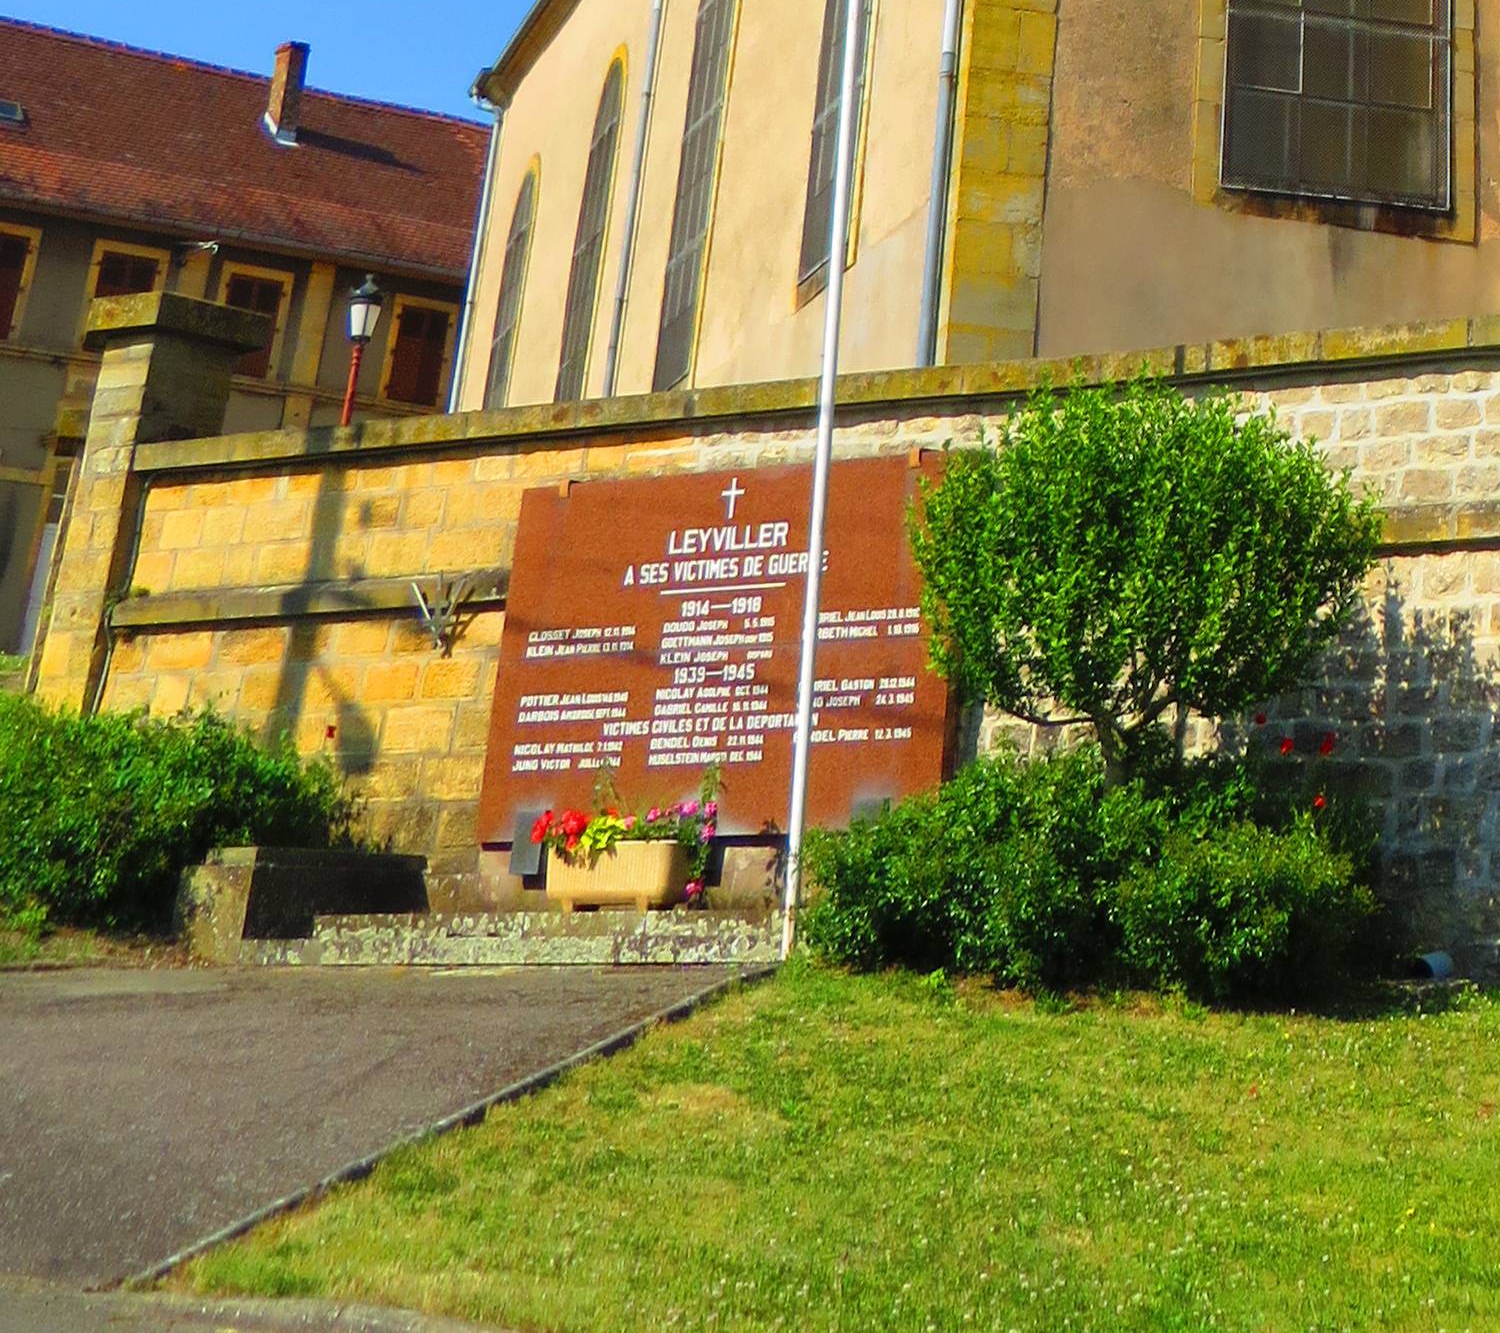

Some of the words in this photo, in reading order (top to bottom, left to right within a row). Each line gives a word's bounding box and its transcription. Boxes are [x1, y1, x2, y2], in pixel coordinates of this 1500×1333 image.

[668, 522, 789, 555] LEYVILLER
[624, 565, 634, 586] A
[640, 562, 669, 585] SES
[674, 556, 740, 582] VICTIMES
[743, 554, 764, 577] DE
[768, 550, 829, 576] GUERE
[696, 620, 729, 631] JOSEPH
[660, 652, 691, 664] KLEIN
[694, 651, 729, 662] JOSEPH
[656, 688, 695, 700] NICOLAY
[603, 720, 650, 736] VICTIMES
[652, 718, 693, 733] CIVILES
[695, 717, 710, 731] ET
[712, 716, 726, 731] DE
[729, 715, 744, 730] LA
